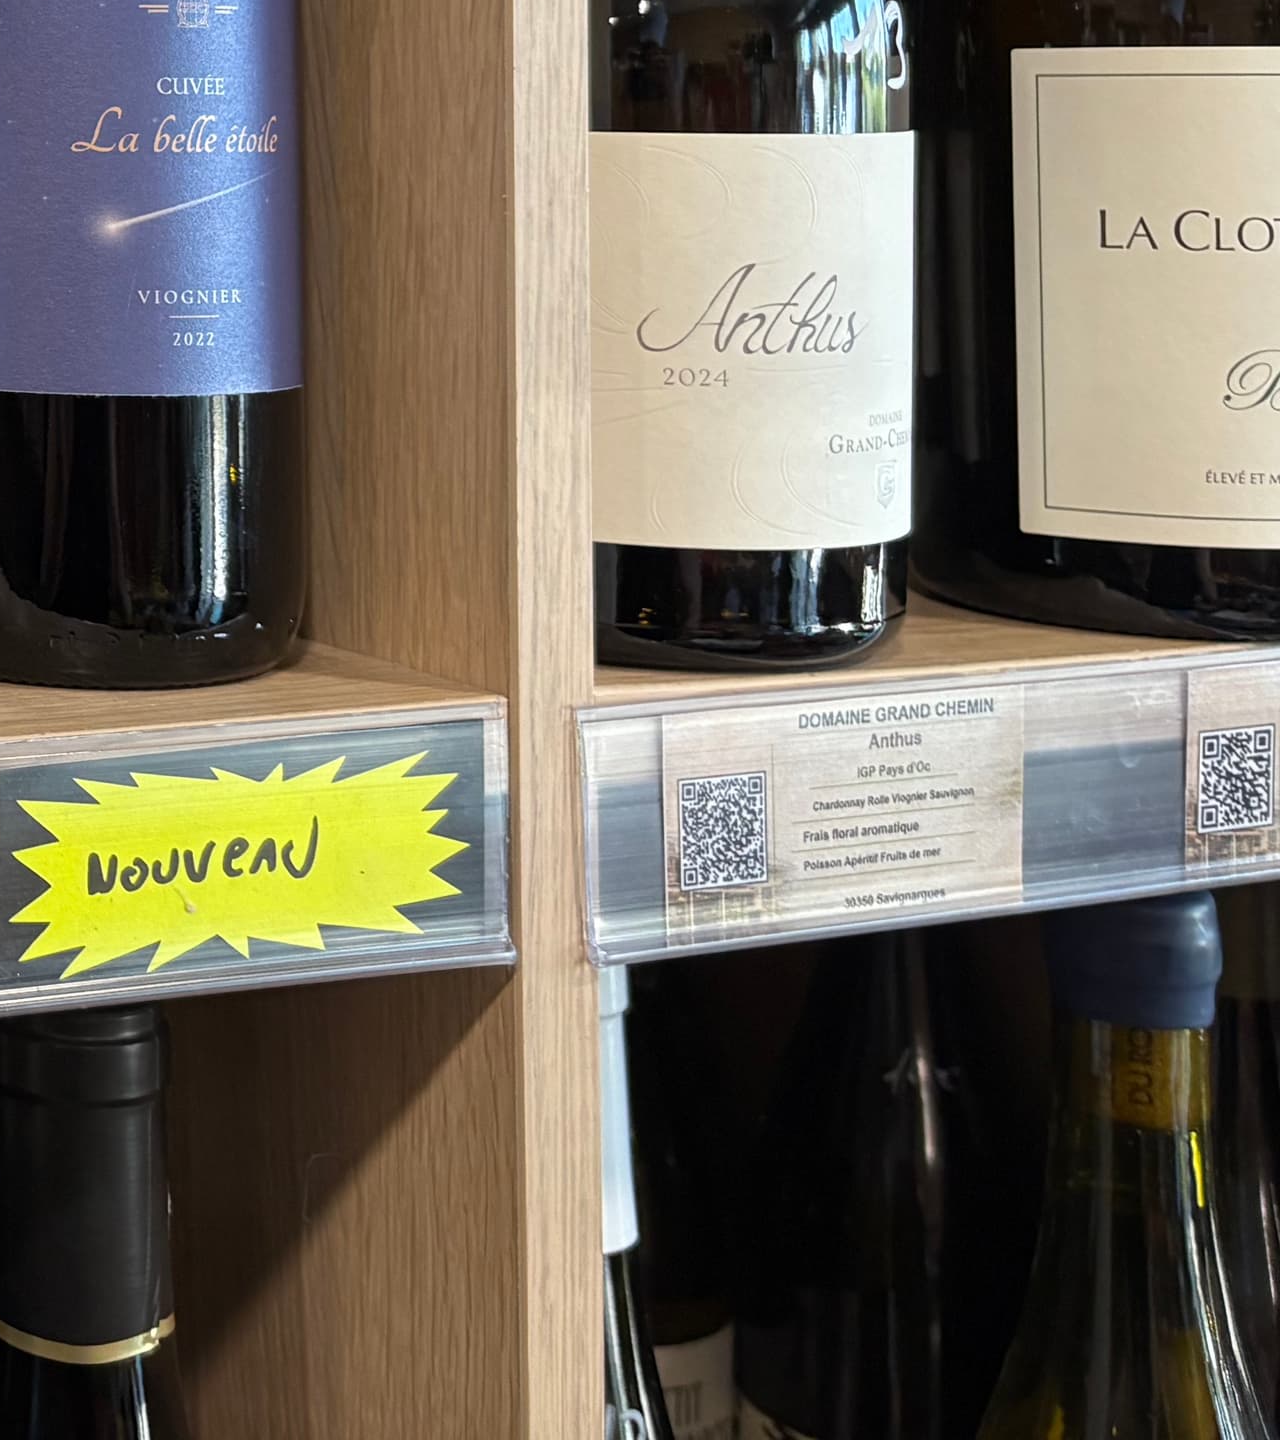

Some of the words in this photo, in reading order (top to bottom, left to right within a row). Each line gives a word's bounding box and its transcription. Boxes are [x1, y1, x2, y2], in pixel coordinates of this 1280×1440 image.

[156, 75, 226, 97] CUVÉE
[70, 105, 140, 154] La
[152, 114, 218, 154] belle
[225, 115, 278, 154] étoile
[1099, 209, 1159, 250] LA
[138, 288, 242, 305] VIOGNIER
[636, 262, 862, 356] Anthus
[173, 331, 215, 347] 2022
[662, 366, 730, 389] 2024
[1205, 468, 1246, 485] ÉLEVÉ
[1250, 472, 1266, 485] ET
[798, 708, 871, 729] DOMAINE
[875, 703, 931, 723] GRAND
[935, 698, 995, 717] CHEMIN
[868, 731, 922, 750] Anthus
[857, 765, 876, 778] IGP
[879, 763, 904, 777] Pays
[907, 760, 931, 774] d'Oc
[813, 796, 866, 812] Chardonnay
[892, 790, 927, 805] Viognier
[929, 786, 975, 801] Sauvignon
[803, 830, 829, 843] Frais
[832, 826, 859, 840] floral
[861, 821, 919, 838] aromatique
[803, 857, 842, 871] Poisson
[880, 849, 907, 863] Fruits
[909, 848, 921, 860] de
[923, 847, 942, 858] mer
